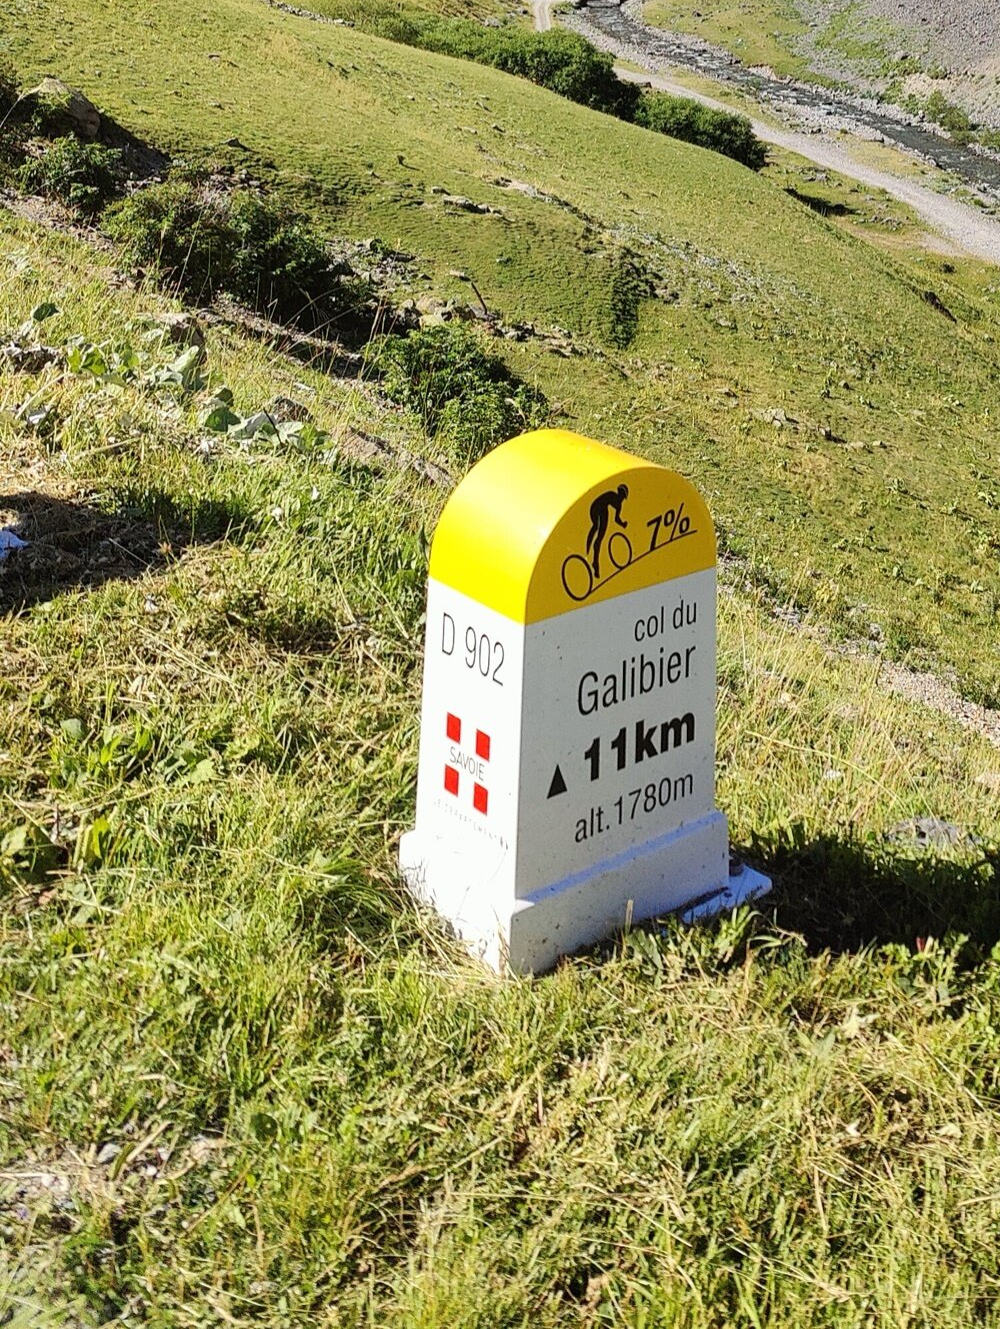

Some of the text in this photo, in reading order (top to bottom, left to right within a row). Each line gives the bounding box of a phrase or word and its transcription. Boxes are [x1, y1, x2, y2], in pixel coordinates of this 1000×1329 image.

[647, 502, 690, 552] 7%
[634, 599, 697, 642] col du
[441, 612, 505, 687] D 902
[577, 645, 696, 716] Galibier
[449, 746, 485, 781] SAVOIE
